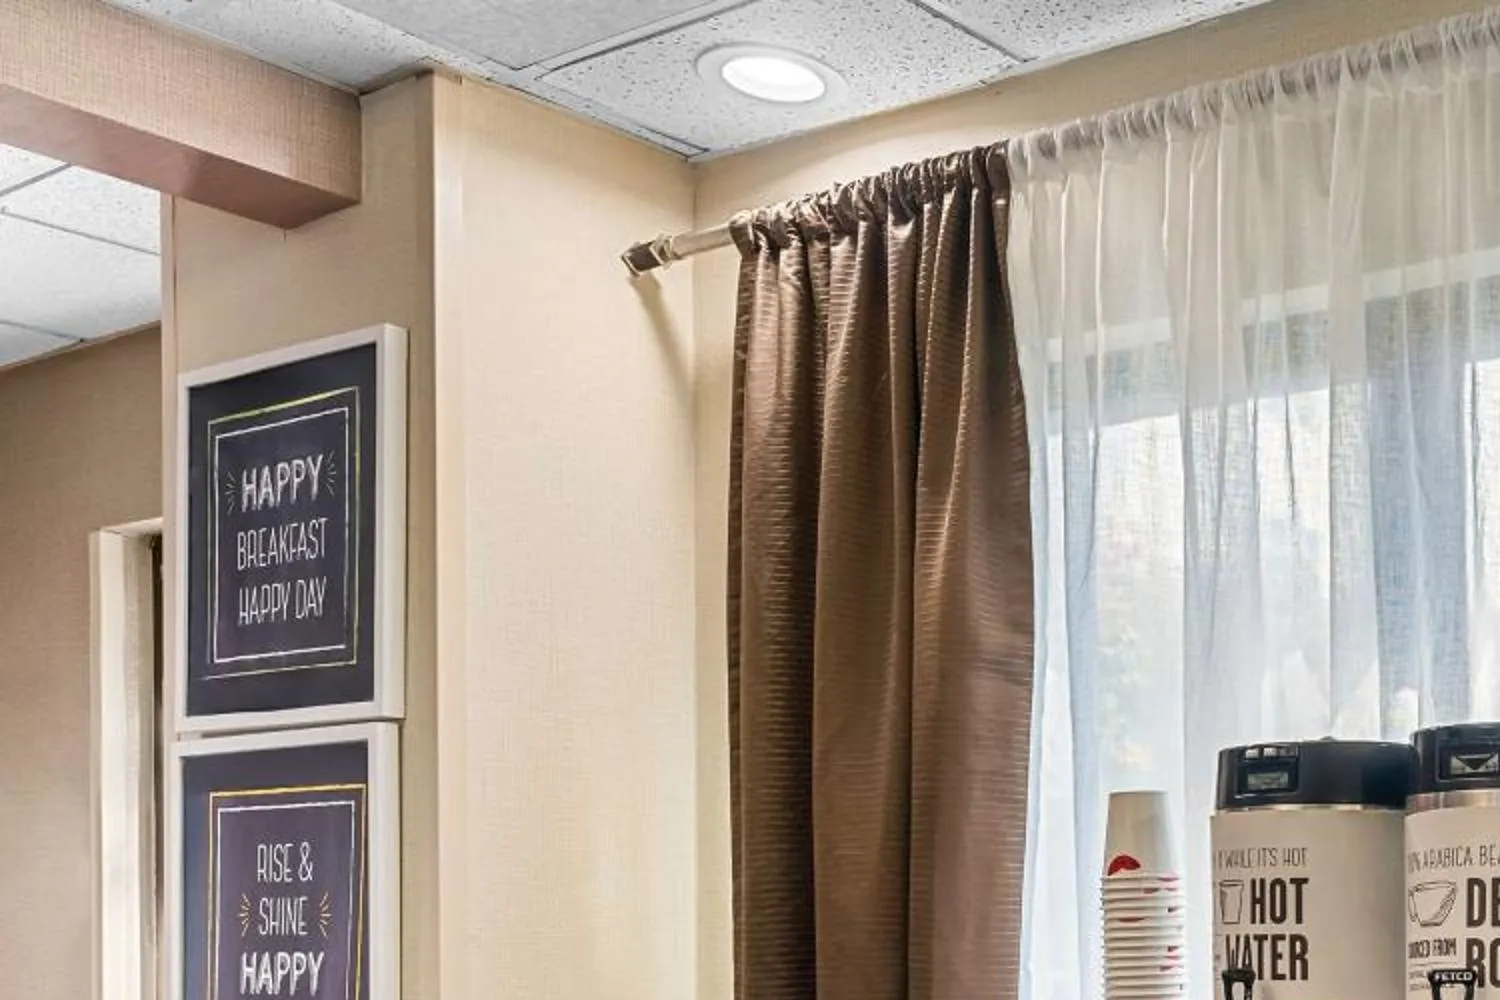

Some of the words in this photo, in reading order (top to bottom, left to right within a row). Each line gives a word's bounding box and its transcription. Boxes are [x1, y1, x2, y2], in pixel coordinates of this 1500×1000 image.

[241, 454, 324, 513] HAPPY
[237, 517, 328, 571] BREAKFAST
[238, 581, 291, 627] HAPPY
[295, 576, 327, 619] DAY
[257, 843, 294, 883] RISE
[299, 842, 314, 882] &
[1283, 847, 1308, 867] HOT
[1422, 846, 1473, 870] ARABICA
[258, 895, 308, 937] SHINE
[1249, 877, 1310, 925] HOT
[239, 951, 325, 997] HAPPY
[1225, 933, 1310, 981] WATER
[1434, 970, 1473, 982] FETCO
